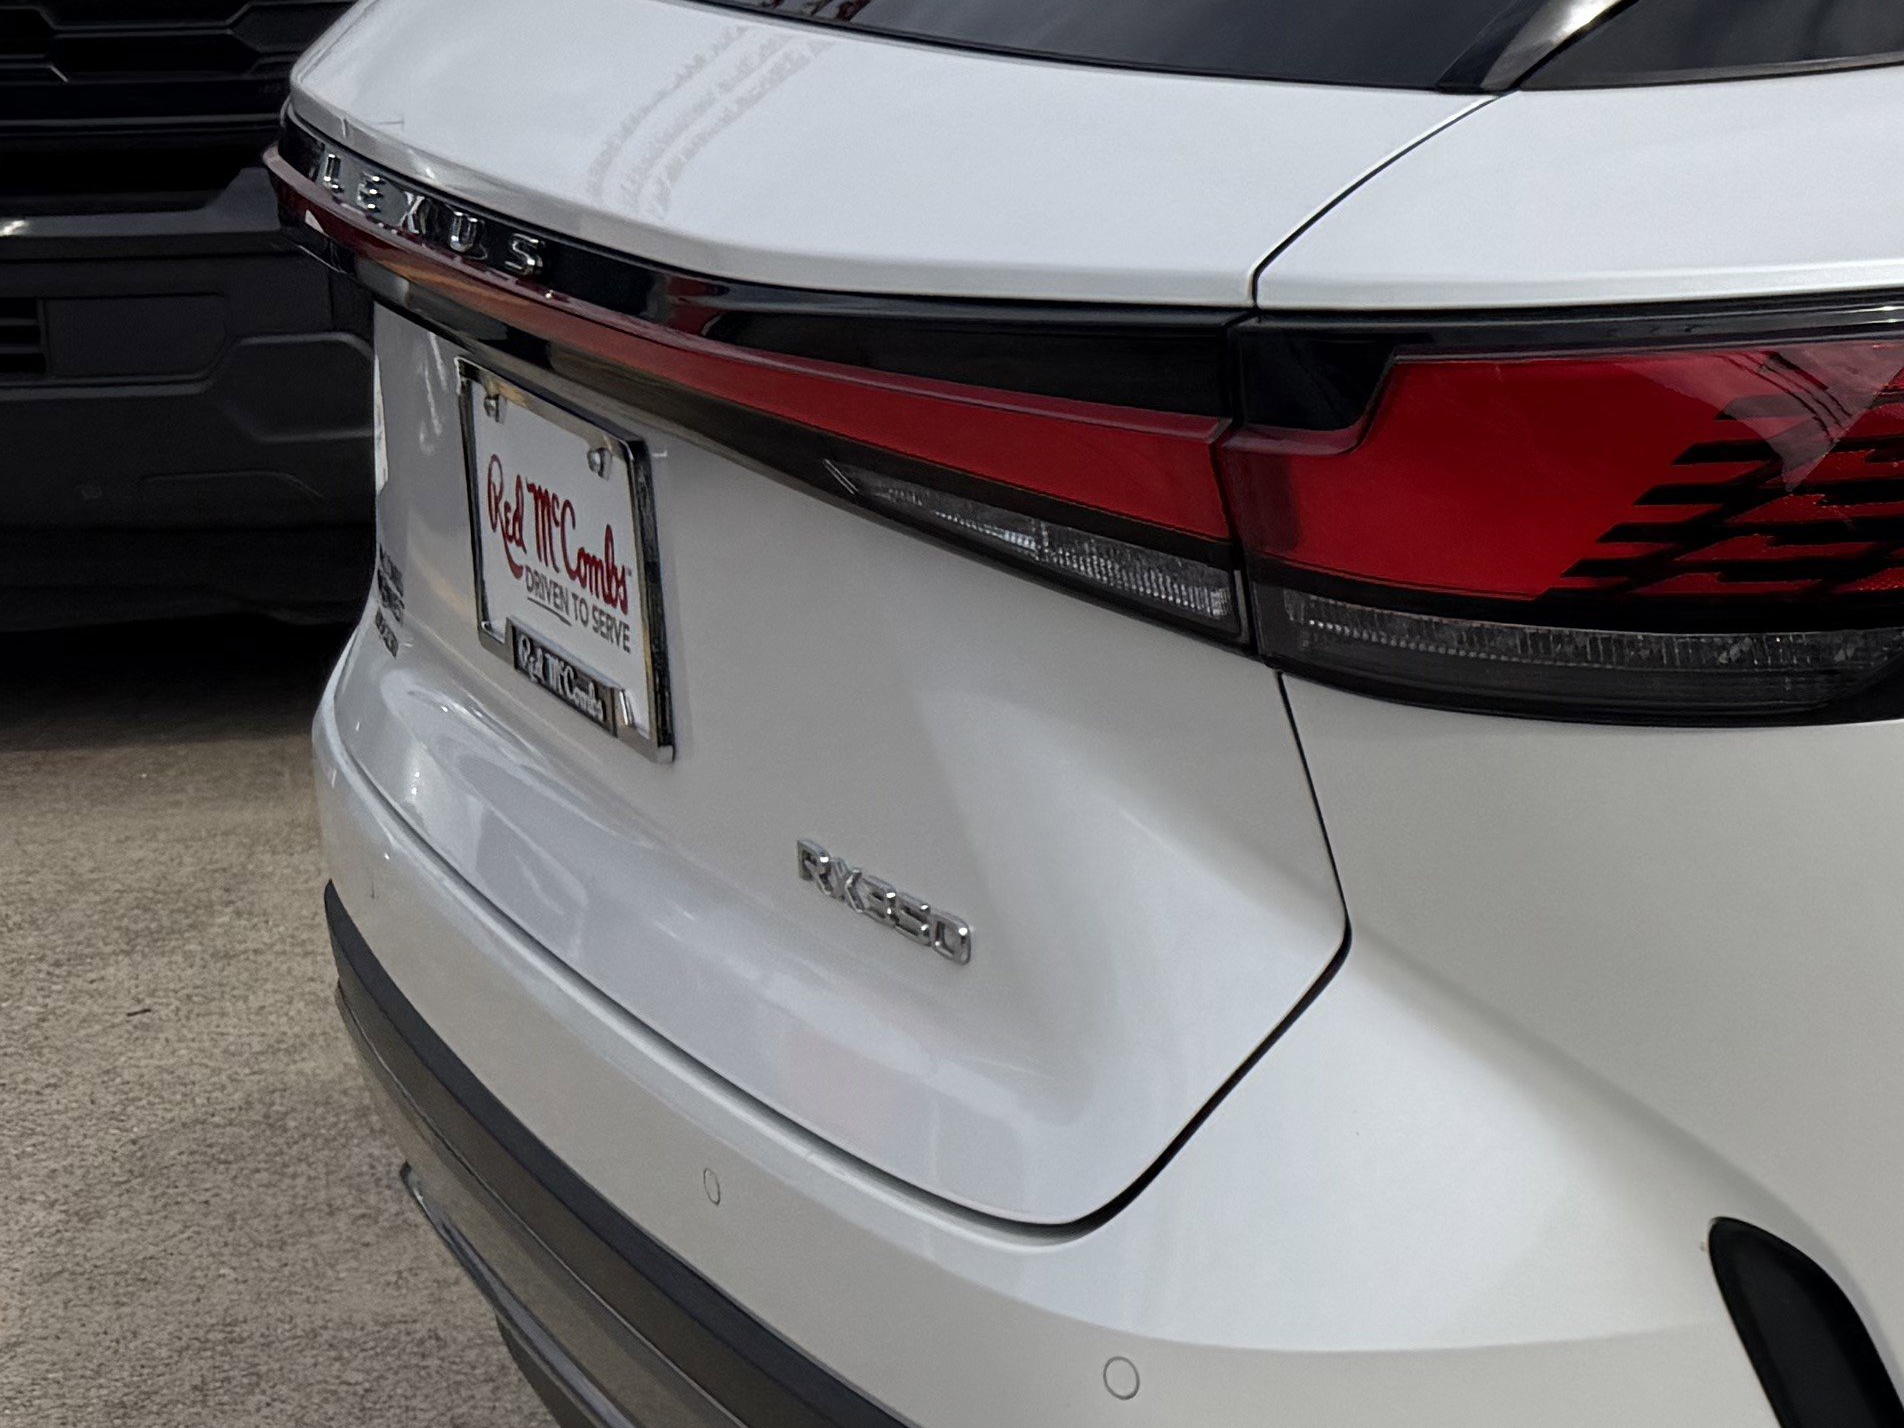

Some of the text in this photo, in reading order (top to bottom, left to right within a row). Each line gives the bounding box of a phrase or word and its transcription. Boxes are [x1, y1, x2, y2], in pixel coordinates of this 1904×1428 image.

[321, 152, 546, 276] LEXUS
[487, 453, 528, 580] Red
[525, 476, 629, 616] McCombs
[524, 564, 632, 655] DRIVEN TO SERVE
